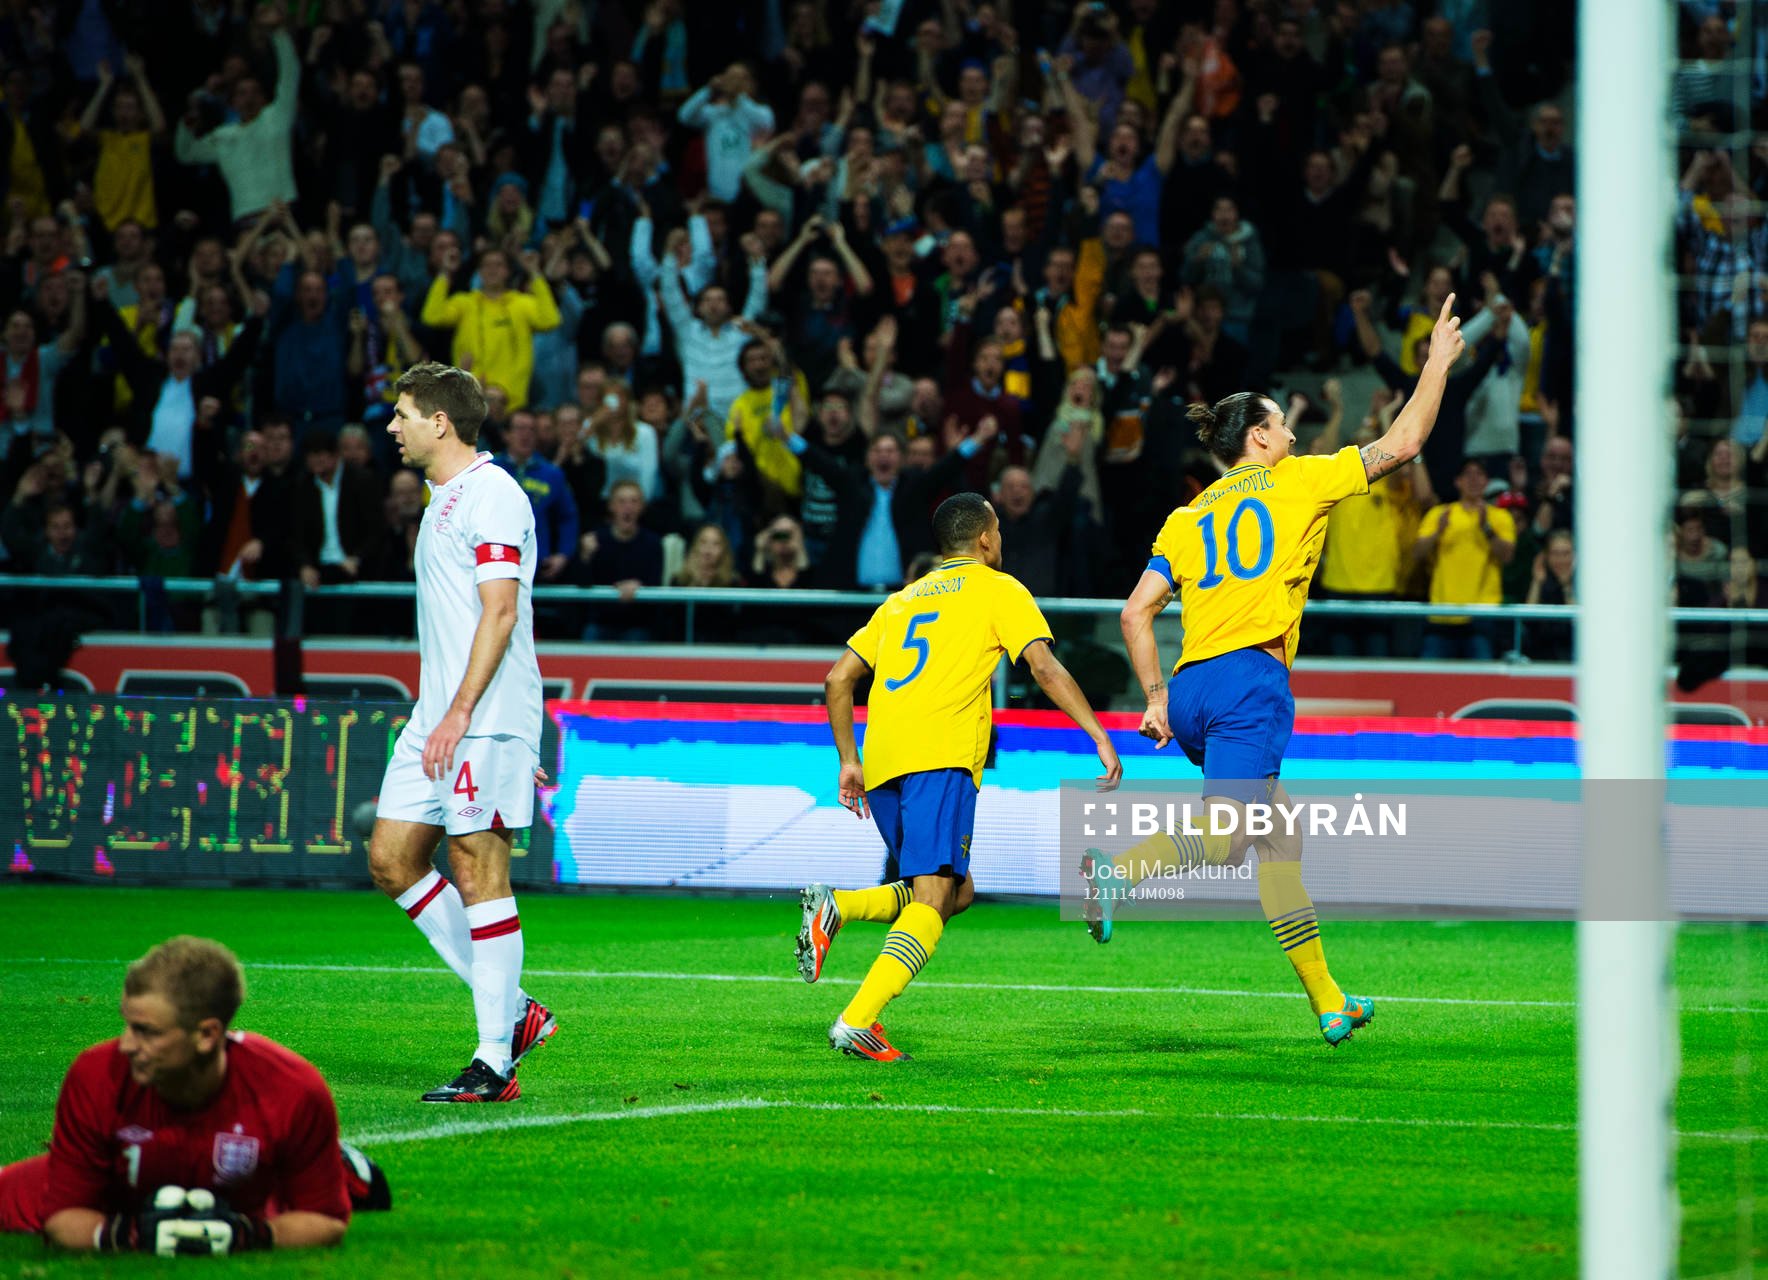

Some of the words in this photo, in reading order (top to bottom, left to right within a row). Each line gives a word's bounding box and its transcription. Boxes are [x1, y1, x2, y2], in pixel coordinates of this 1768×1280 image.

[1197, 497, 1275, 590] 10
[885, 611, 940, 692] 5
[453, 761, 479, 802] 4
[122, 1144, 142, 1187] 1
